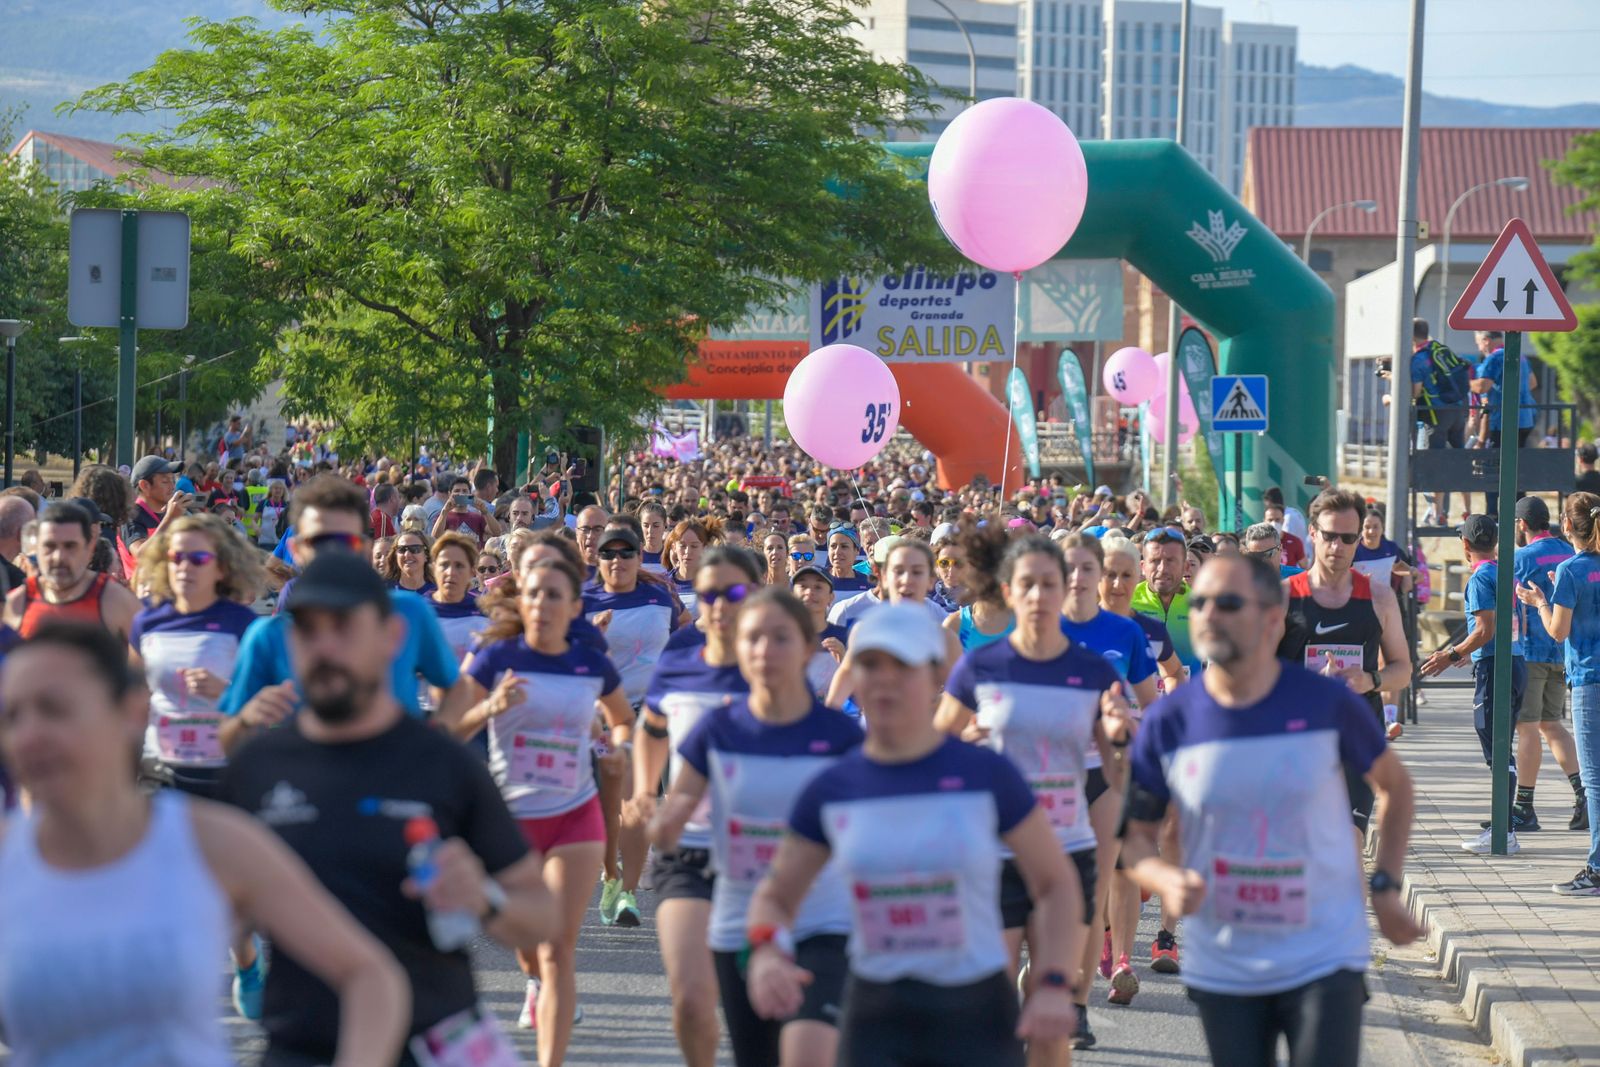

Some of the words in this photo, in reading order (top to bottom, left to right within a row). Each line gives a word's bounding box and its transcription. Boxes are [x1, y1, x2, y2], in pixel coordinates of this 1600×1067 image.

[883, 265, 997, 296] olimpo
[879, 294, 952, 310] deportes
[910, 310, 964, 321] Granada
[876, 324, 1006, 357] SALIDA
[861, 403, 892, 443] 35'
